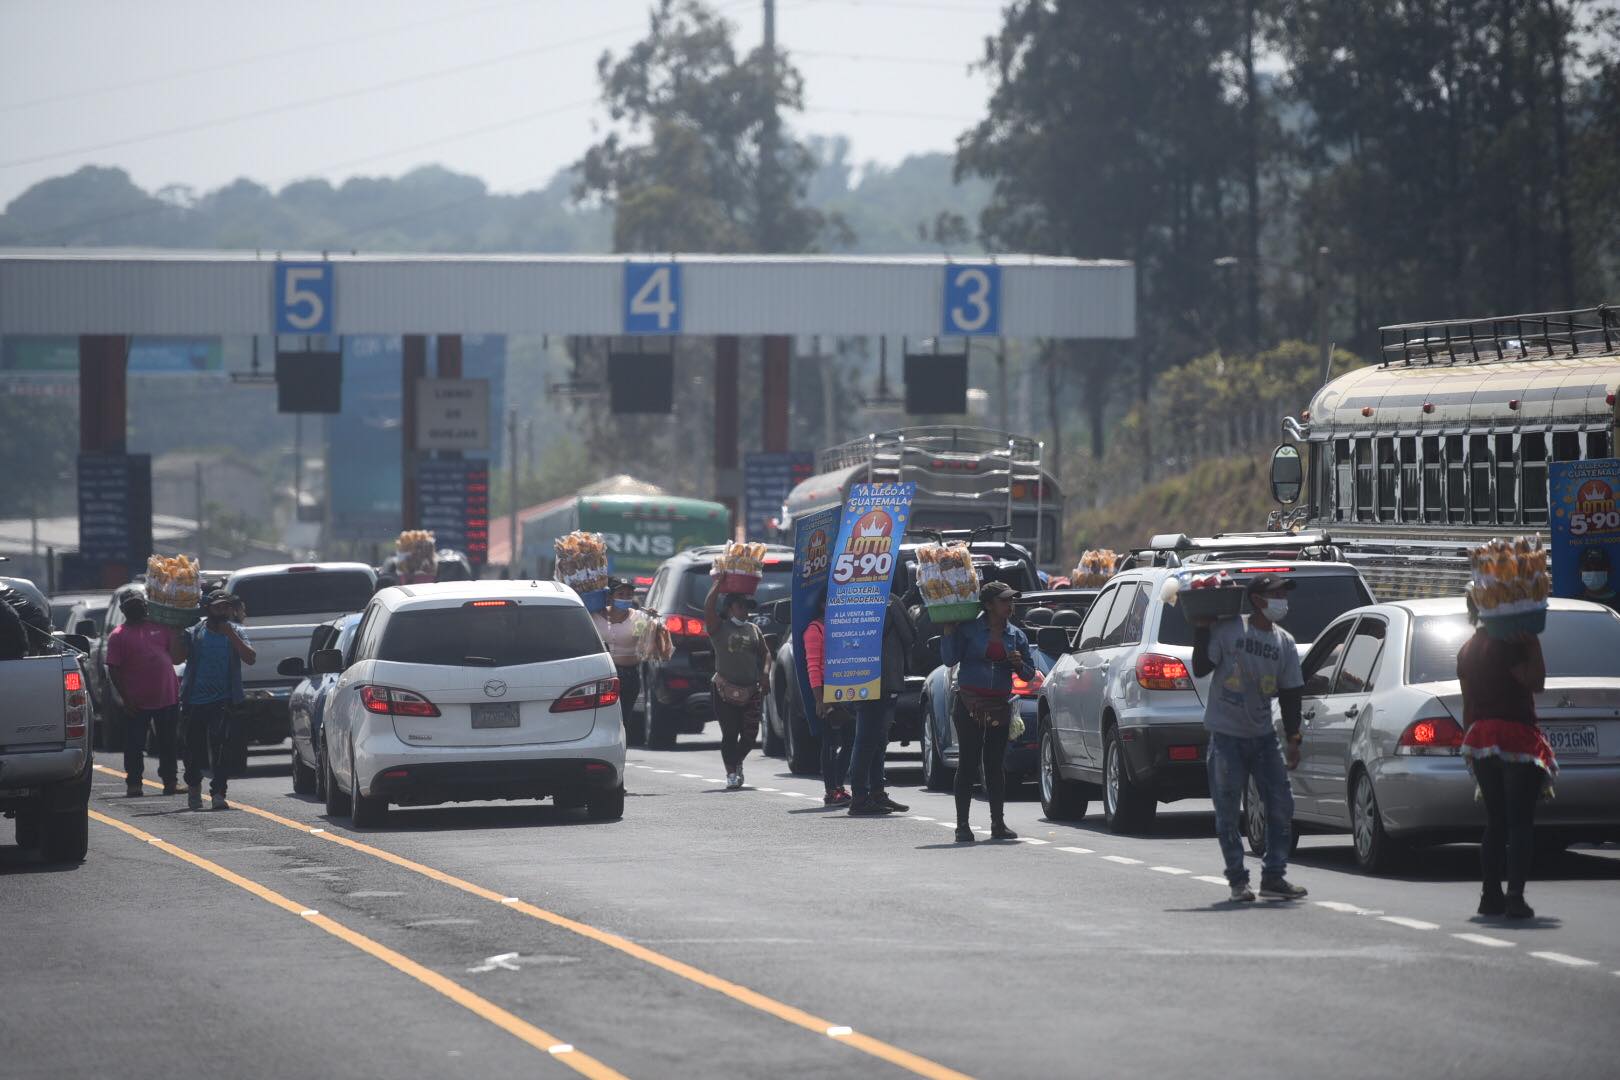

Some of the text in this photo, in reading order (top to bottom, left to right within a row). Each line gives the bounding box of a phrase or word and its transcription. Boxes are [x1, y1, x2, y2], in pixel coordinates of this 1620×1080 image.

[284, 268, 324, 328] 5
[631, 267, 676, 328] 4
[952, 269, 990, 330] 3
[851, 497, 907, 506] GUATEMALA
[858, 489, 869, 497] YA
[845, 536, 892, 556] LOTTO
